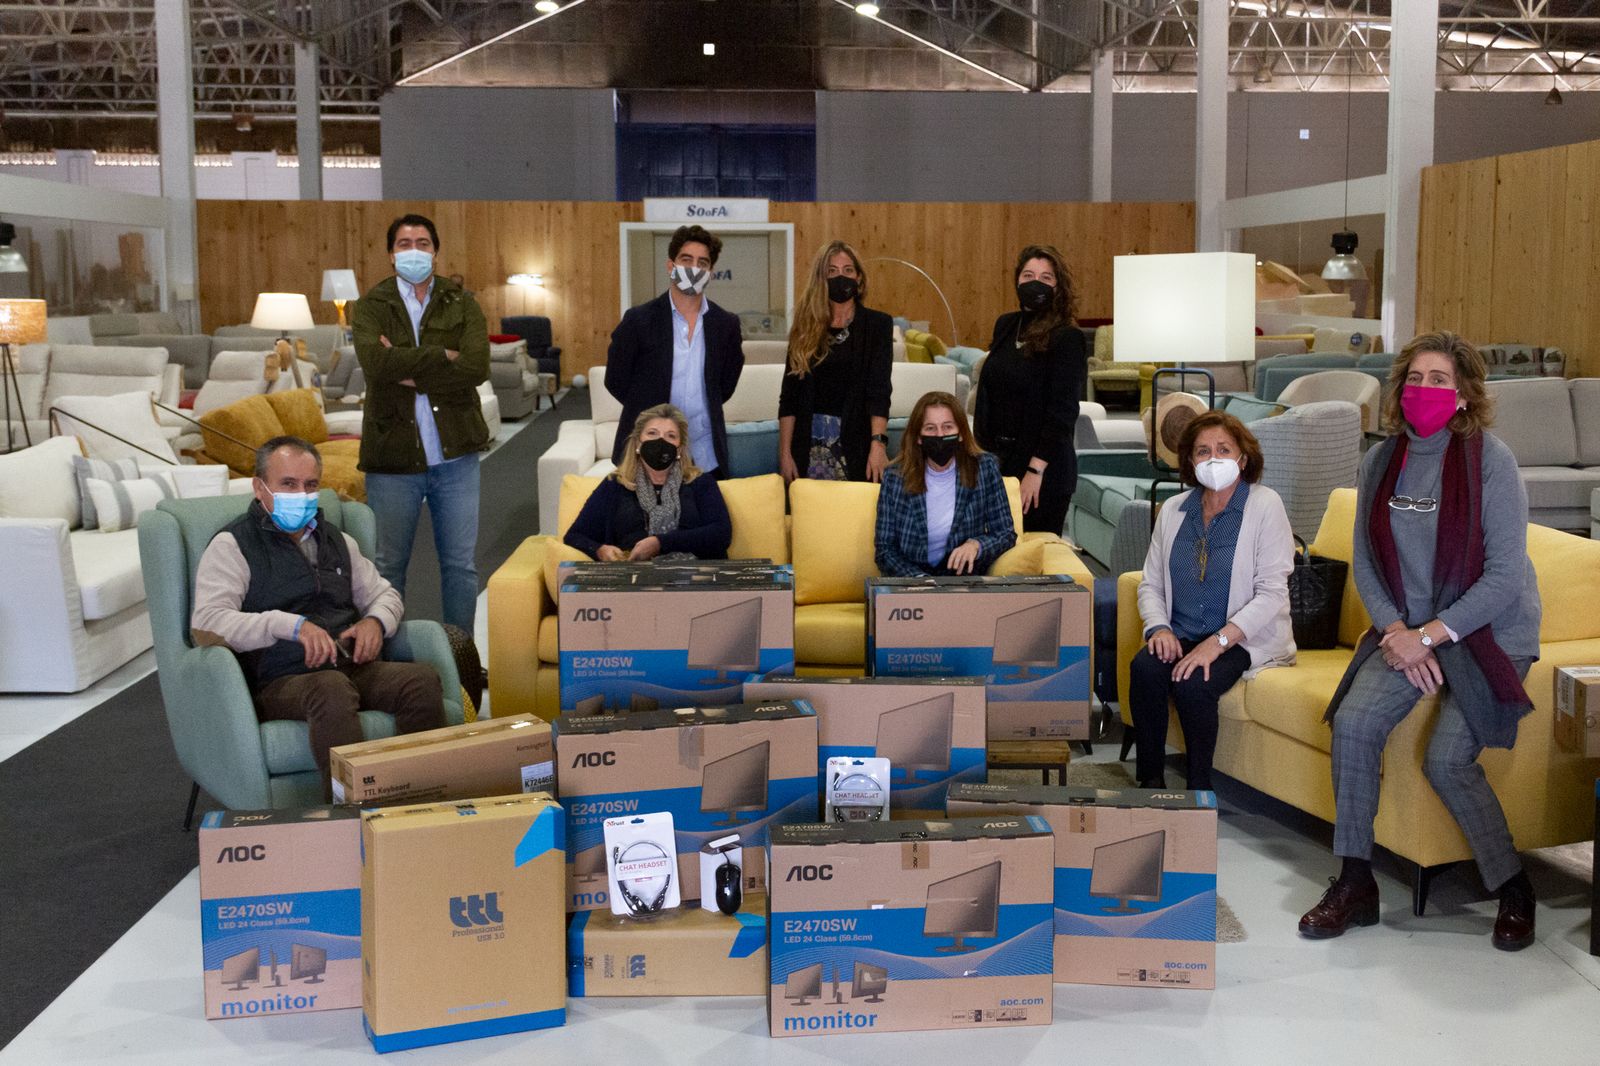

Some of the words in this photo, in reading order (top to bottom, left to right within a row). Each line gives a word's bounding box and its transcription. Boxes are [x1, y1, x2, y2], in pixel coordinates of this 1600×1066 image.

[573, 608, 612, 622] AOC
[888, 608, 924, 621] AOC
[573, 656, 633, 669] E2470SW
[888, 653, 943, 664] E2470SW
[754, 705, 788, 713] AOC
[572, 751, 616, 768] AOC
[363, 789, 376, 797] TTL
[571, 800, 639, 816] E2470SW
[983, 821, 1019, 829] AOC
[217, 845, 266, 864] AOC
[619, 864, 637, 872] CHAT
[638, 860, 667, 869] HEADSET
[786, 864, 833, 882] AOC
[217, 901, 294, 920] E2470SW
[218, 921, 236, 930] LED
[453, 924, 504, 937] Professional
[784, 918, 858, 933] E2470SW
[1164, 961, 1207, 970] aoc.com
[221, 993, 319, 1017] monitor
[1000, 997, 1044, 1007] aoc.com
[784, 1010, 878, 1031] monitor
